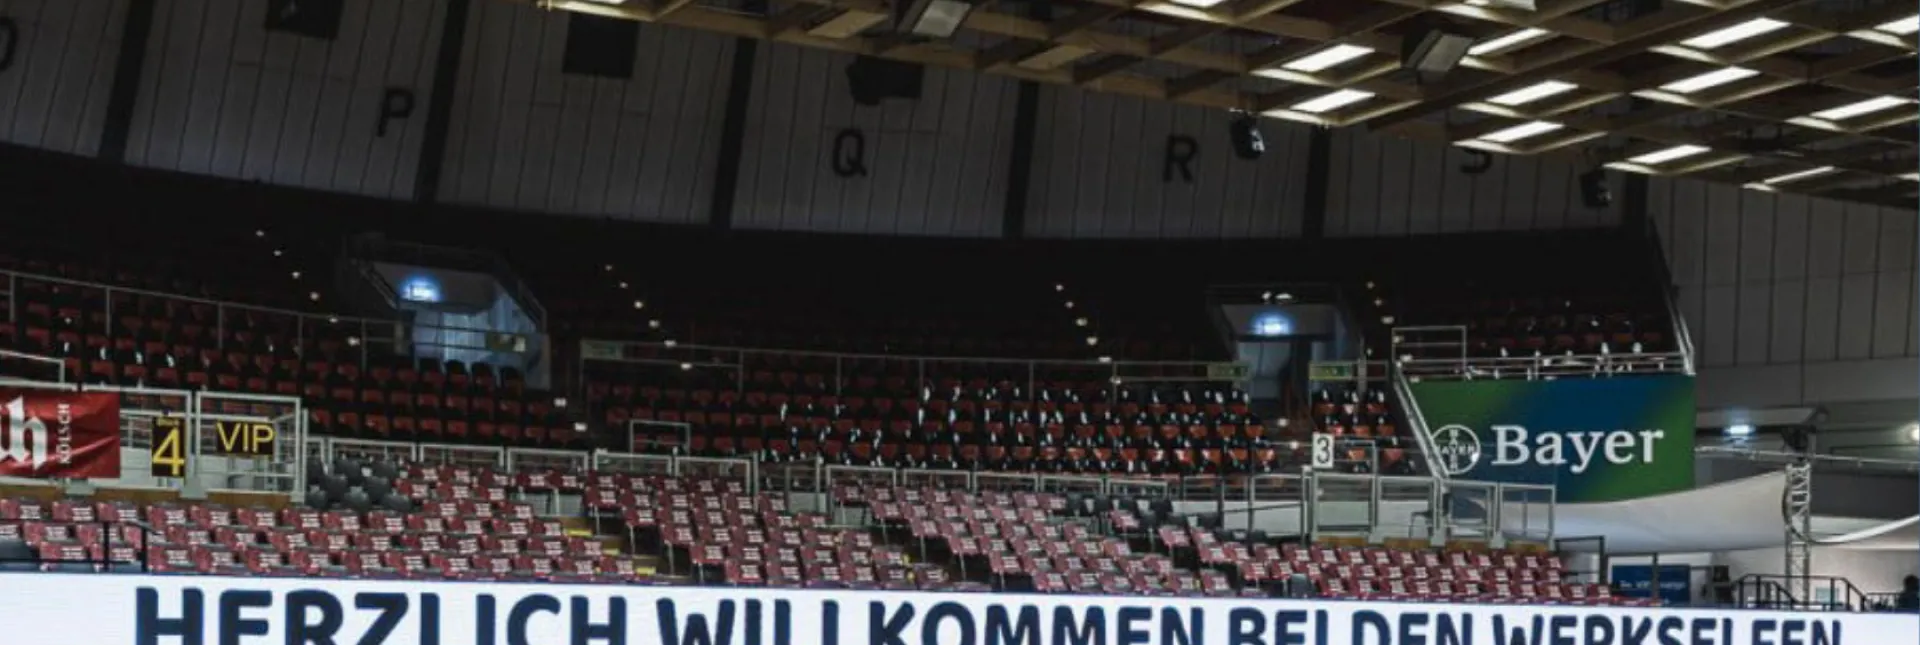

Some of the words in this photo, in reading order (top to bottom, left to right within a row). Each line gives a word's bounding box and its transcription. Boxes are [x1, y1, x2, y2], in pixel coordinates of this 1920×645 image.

[376, 88, 415, 137] P
[832, 128, 867, 178] Q
[1163, 135, 1197, 182] R
[152, 427, 185, 476] 4
[216, 422, 275, 452] VIP
[1317, 436, 1330, 464] 3
[1491, 425, 1664, 473] Bayer
[136, 586, 627, 645] HERZLICH
[656, 597, 1203, 645] WILLKOMMEN
